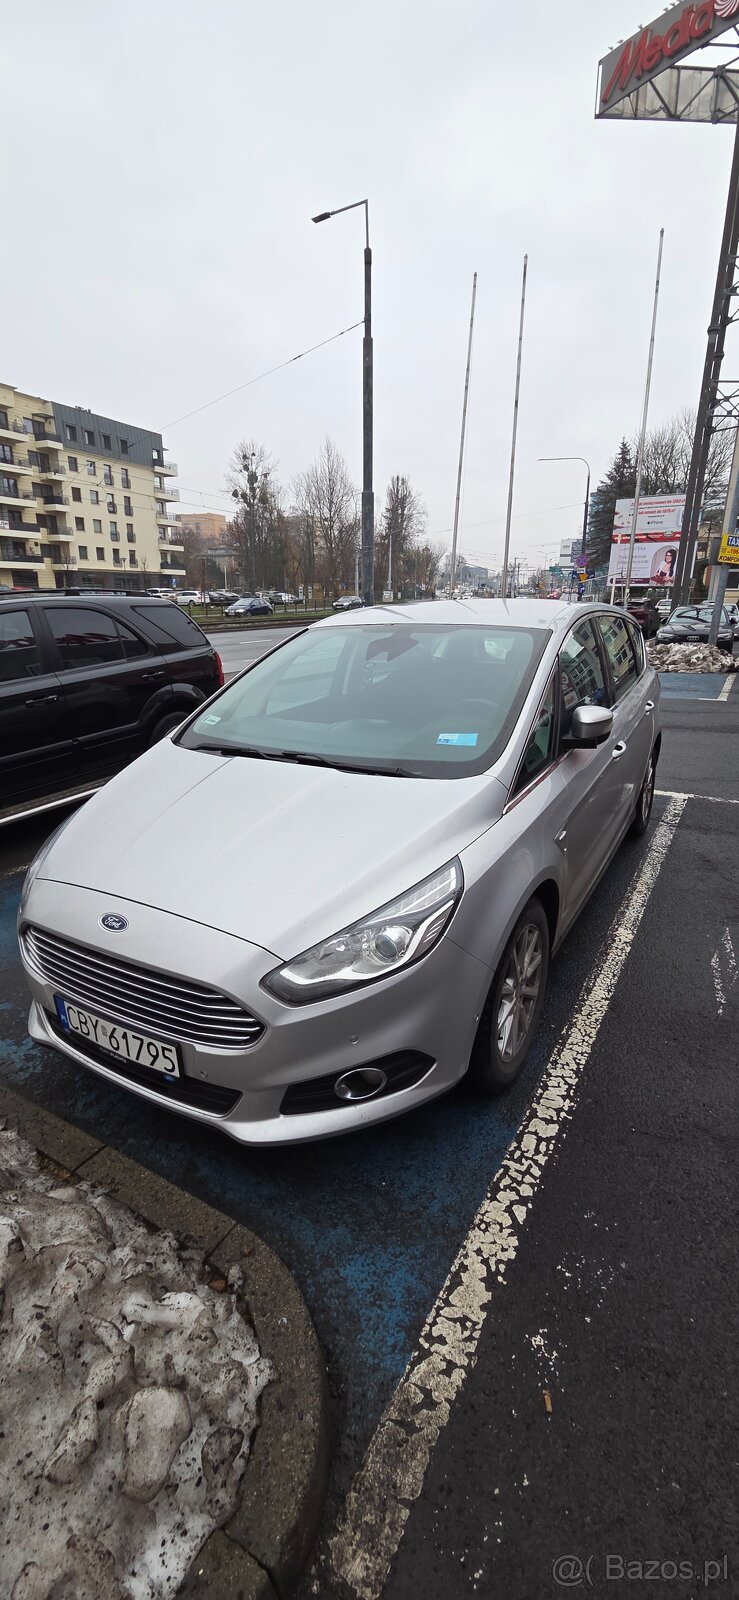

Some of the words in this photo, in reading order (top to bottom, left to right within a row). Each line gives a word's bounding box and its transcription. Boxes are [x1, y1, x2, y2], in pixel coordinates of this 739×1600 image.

[600, 2, 715, 104] Media
[67, 1006, 99, 1042] CBY
[108, 1027, 175, 1073] 61795
